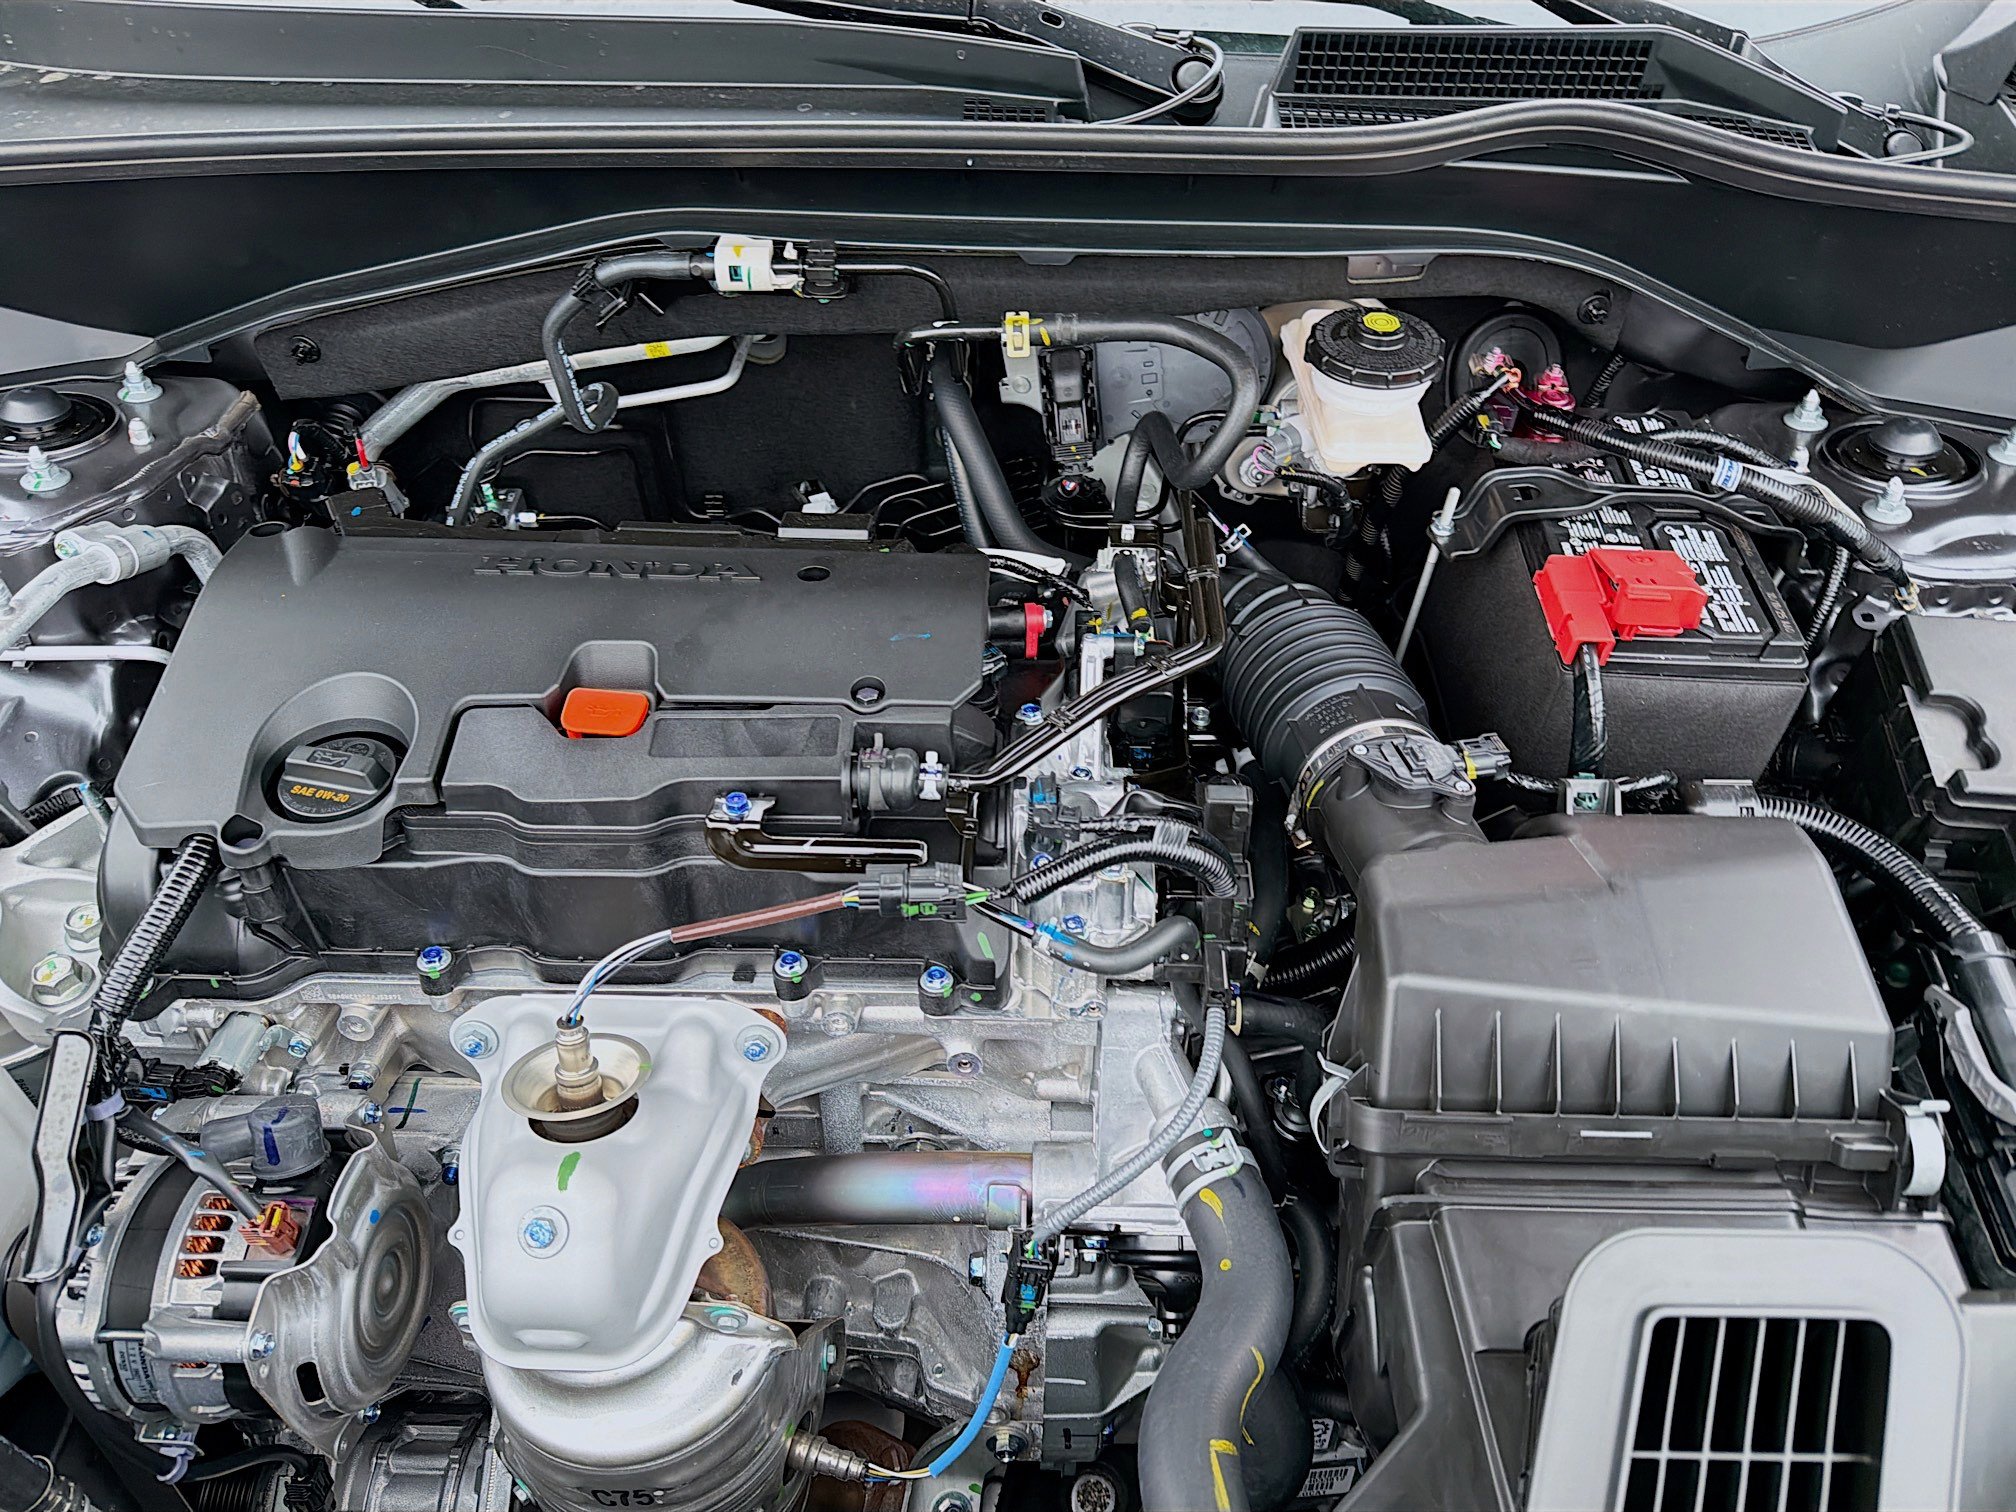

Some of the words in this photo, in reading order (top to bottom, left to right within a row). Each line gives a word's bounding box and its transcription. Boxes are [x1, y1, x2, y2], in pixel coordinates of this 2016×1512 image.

[473, 556, 761, 581] HONDA
[290, 785, 316, 797] SAE
[315, 790, 350, 803] 0W-20
[591, 1489, 655, 1507] C75
